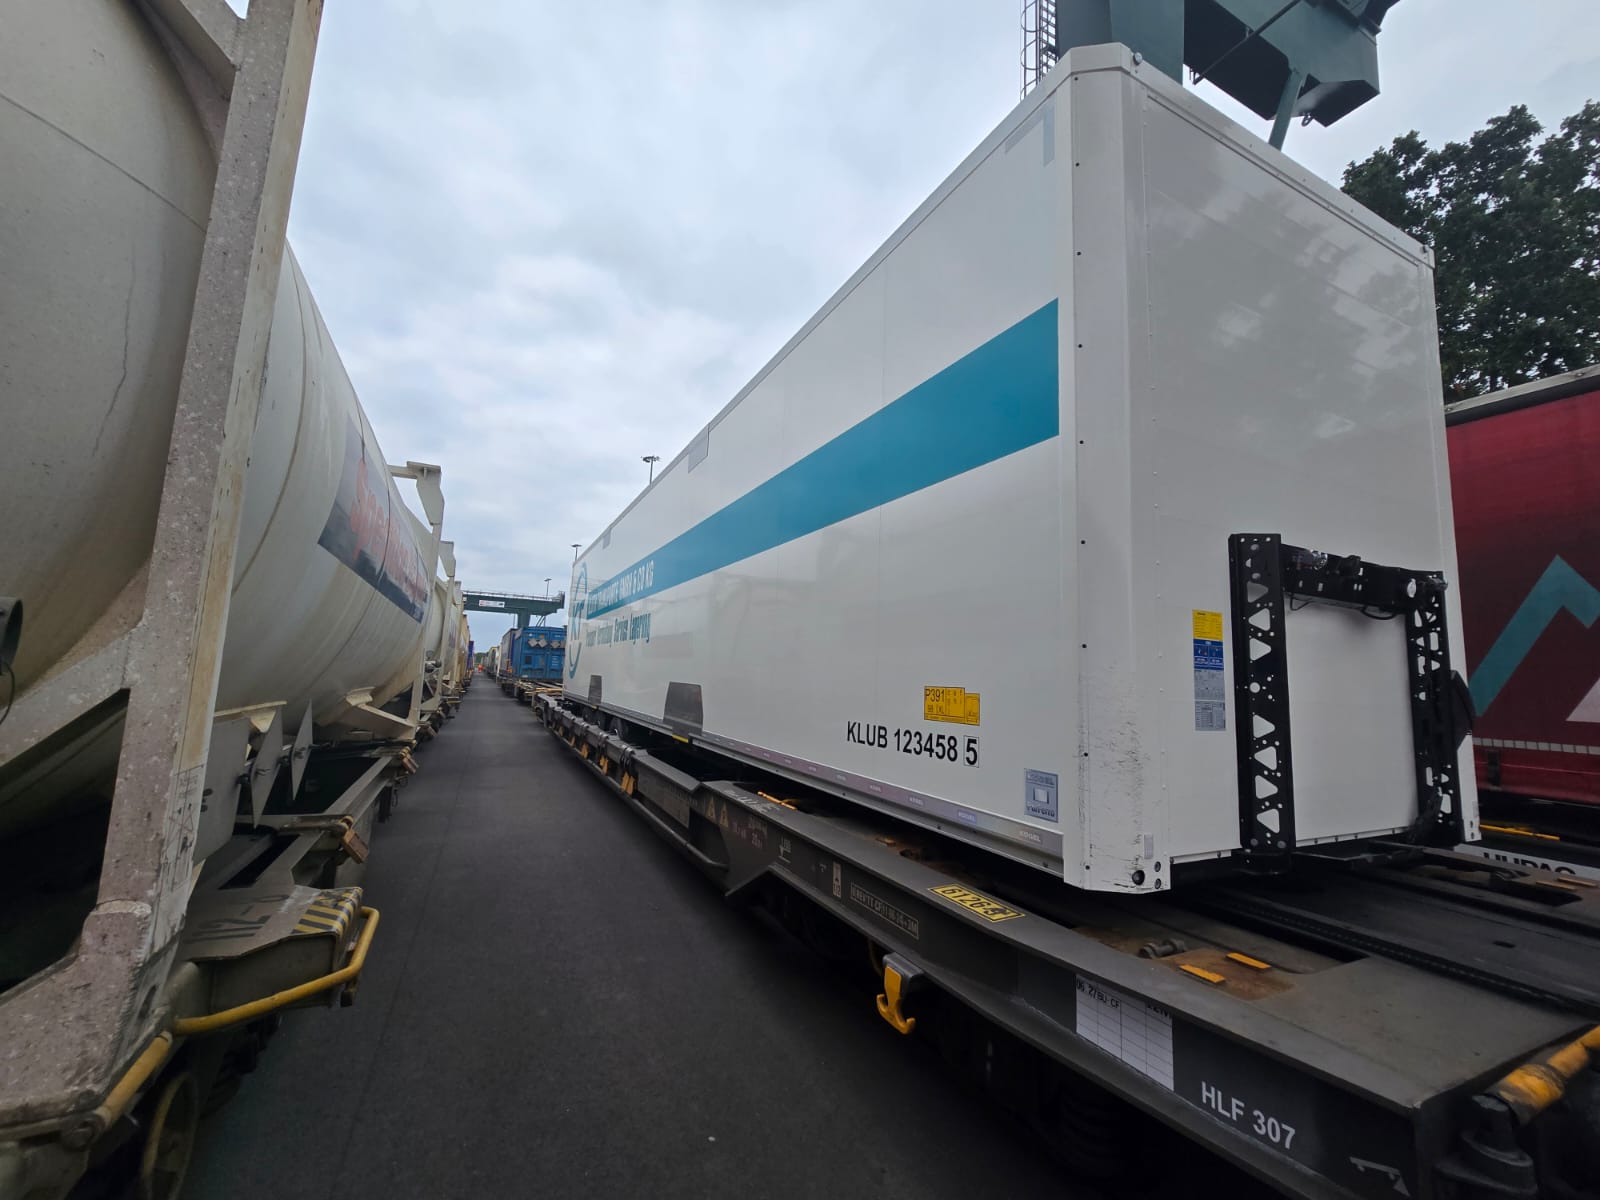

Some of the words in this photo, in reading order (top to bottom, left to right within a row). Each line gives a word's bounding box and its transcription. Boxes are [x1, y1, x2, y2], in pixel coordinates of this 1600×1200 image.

[847, 720, 888, 749] KLUB
[894, 728, 958, 762] 123458
[965, 738, 978, 766] 5
[1201, 1080, 1245, 1121] HLF
[1252, 1109, 1296, 1150] 307
